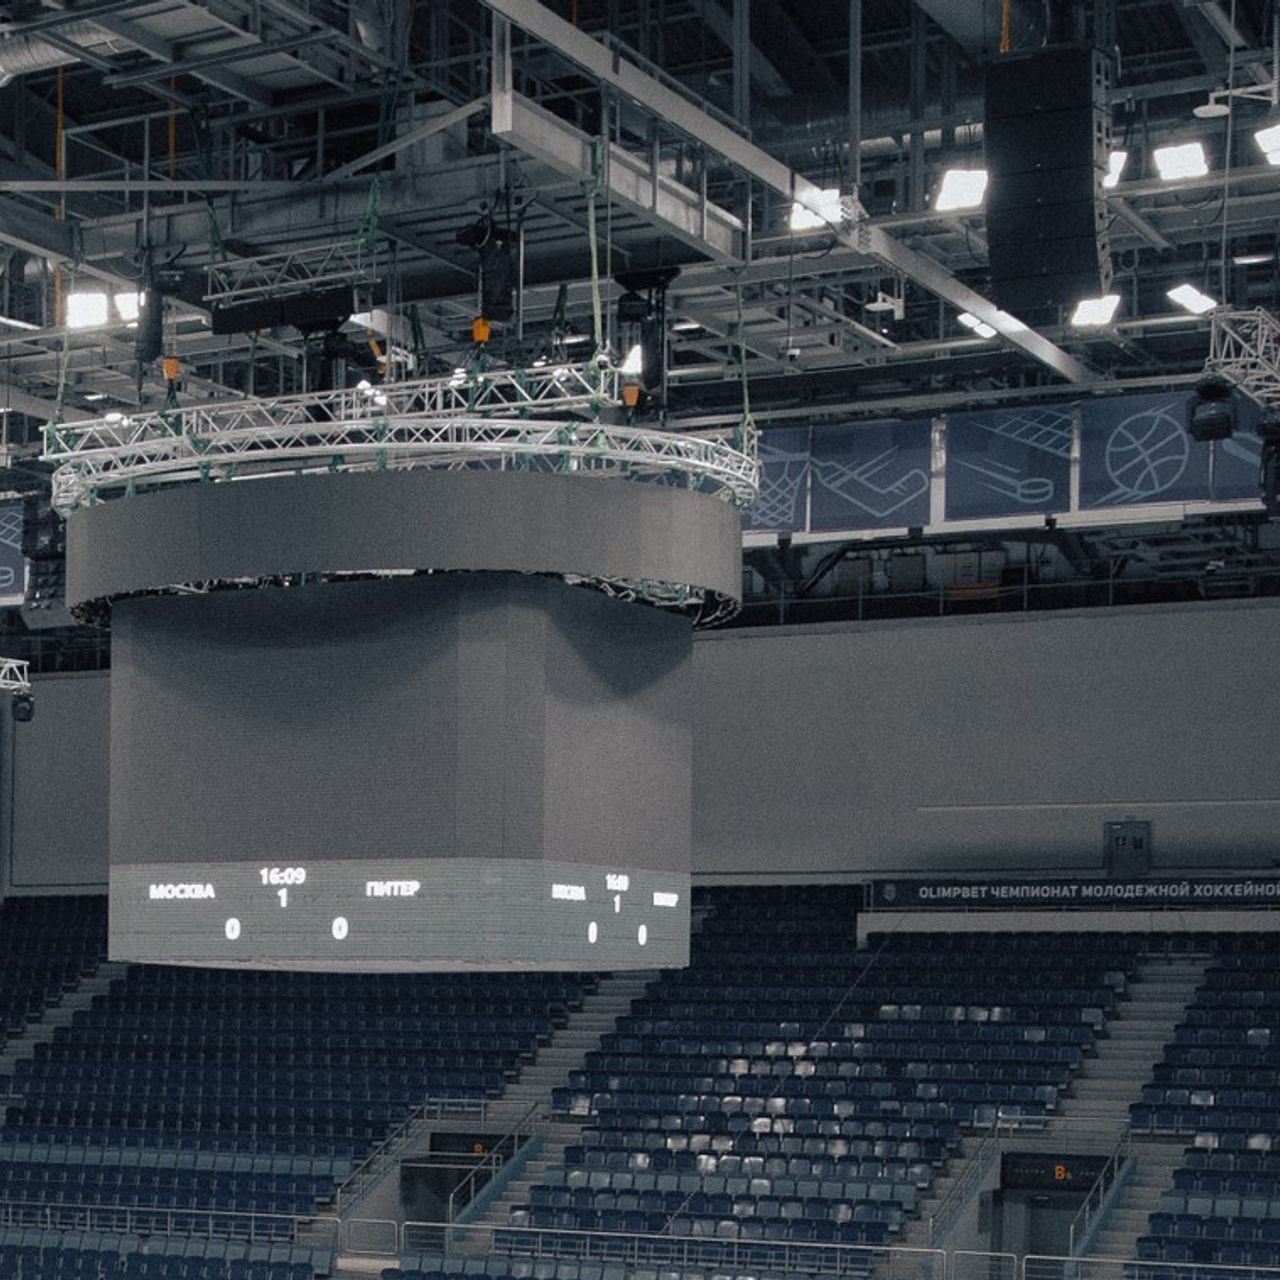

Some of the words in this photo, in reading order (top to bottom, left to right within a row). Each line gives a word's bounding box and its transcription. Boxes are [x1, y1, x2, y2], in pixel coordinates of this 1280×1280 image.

[259, 867, 306, 886] 16:09
[149, 883, 216, 899] МОСКВА
[277, 888, 288, 907] 1
[366, 880, 421, 896] ПИТЕР
[920, 886, 988, 899] OLIMPBET
[991, 885, 1078, 898] ЧЕМПИОНАТ
[1081, 881, 1190, 899] МОЛОДЕЖНОЙ
[613, 894, 621, 913] 1
[225, 917, 241, 940] 0
[332, 916, 348, 940] 0
